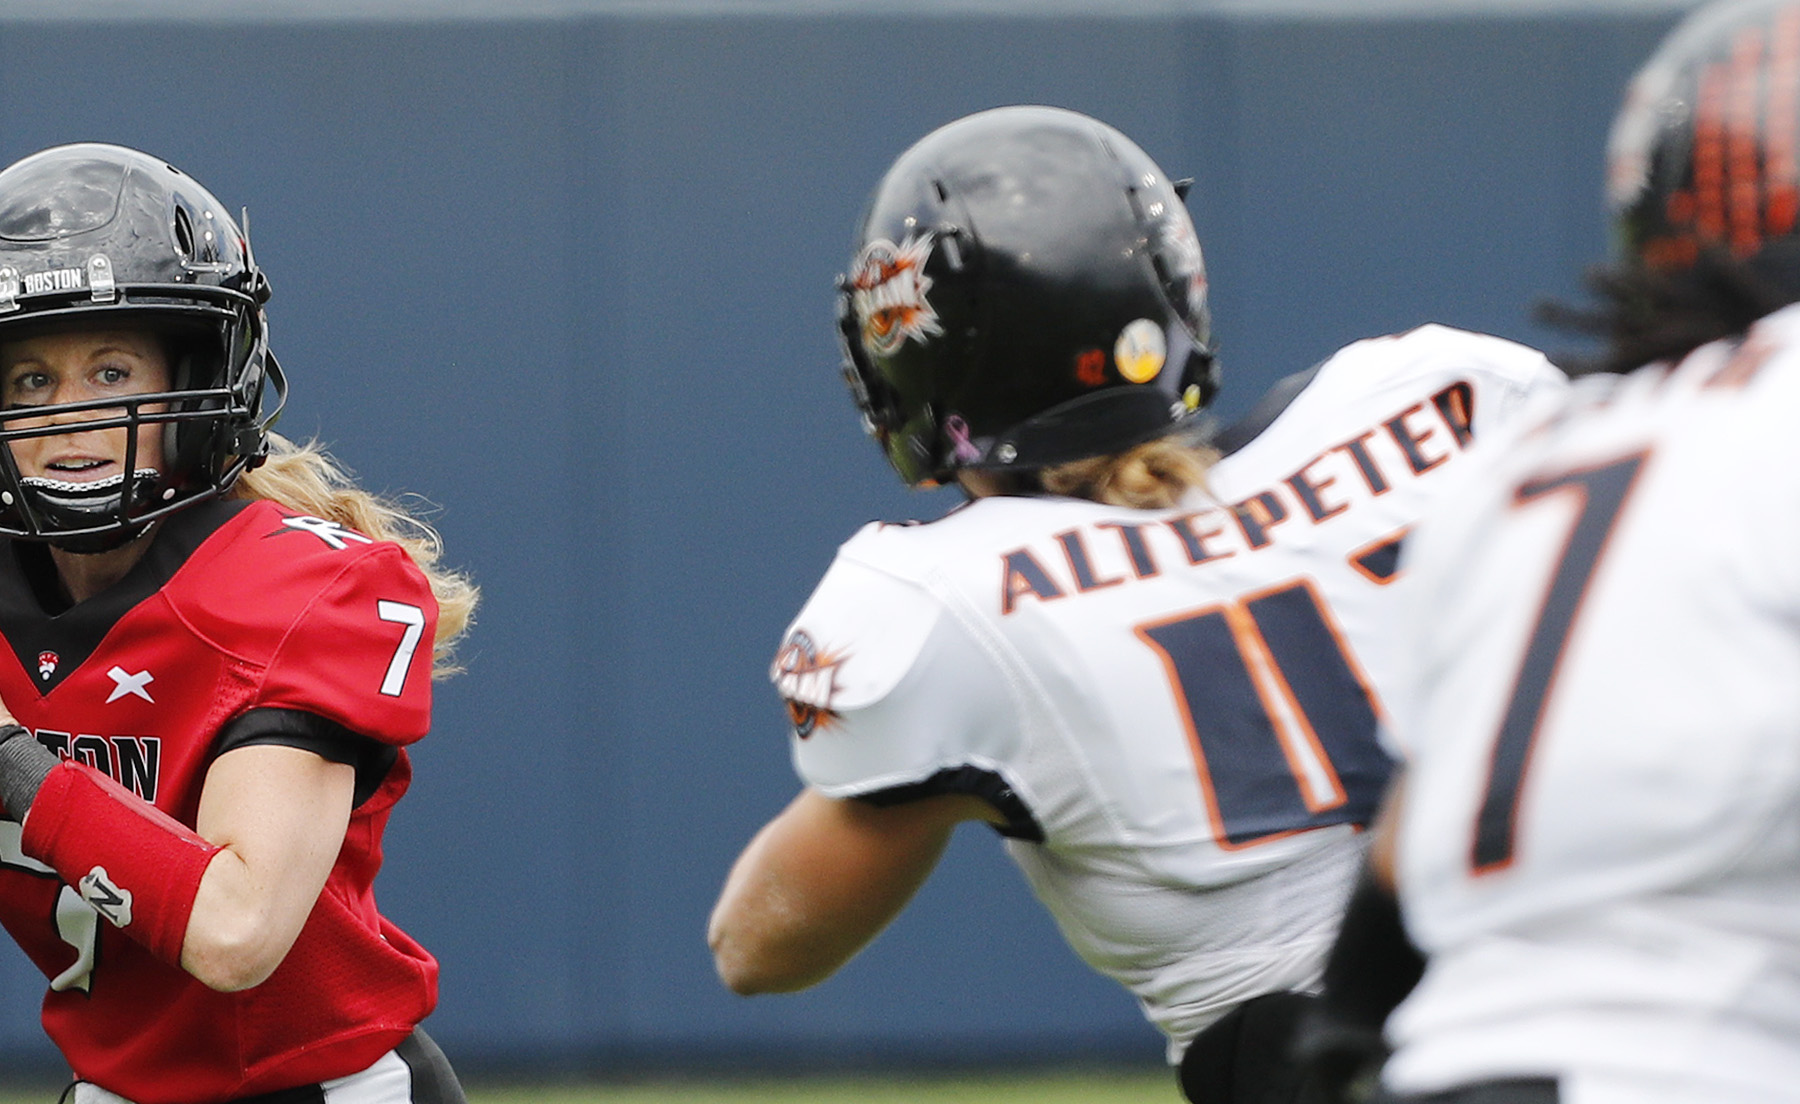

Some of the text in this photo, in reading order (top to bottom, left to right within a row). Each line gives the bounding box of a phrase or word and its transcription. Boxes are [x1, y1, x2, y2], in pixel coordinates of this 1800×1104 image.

[24, 267, 81, 294] BOSTON
[377, 598, 427, 698] 7
[1466, 444, 1655, 876] 7
